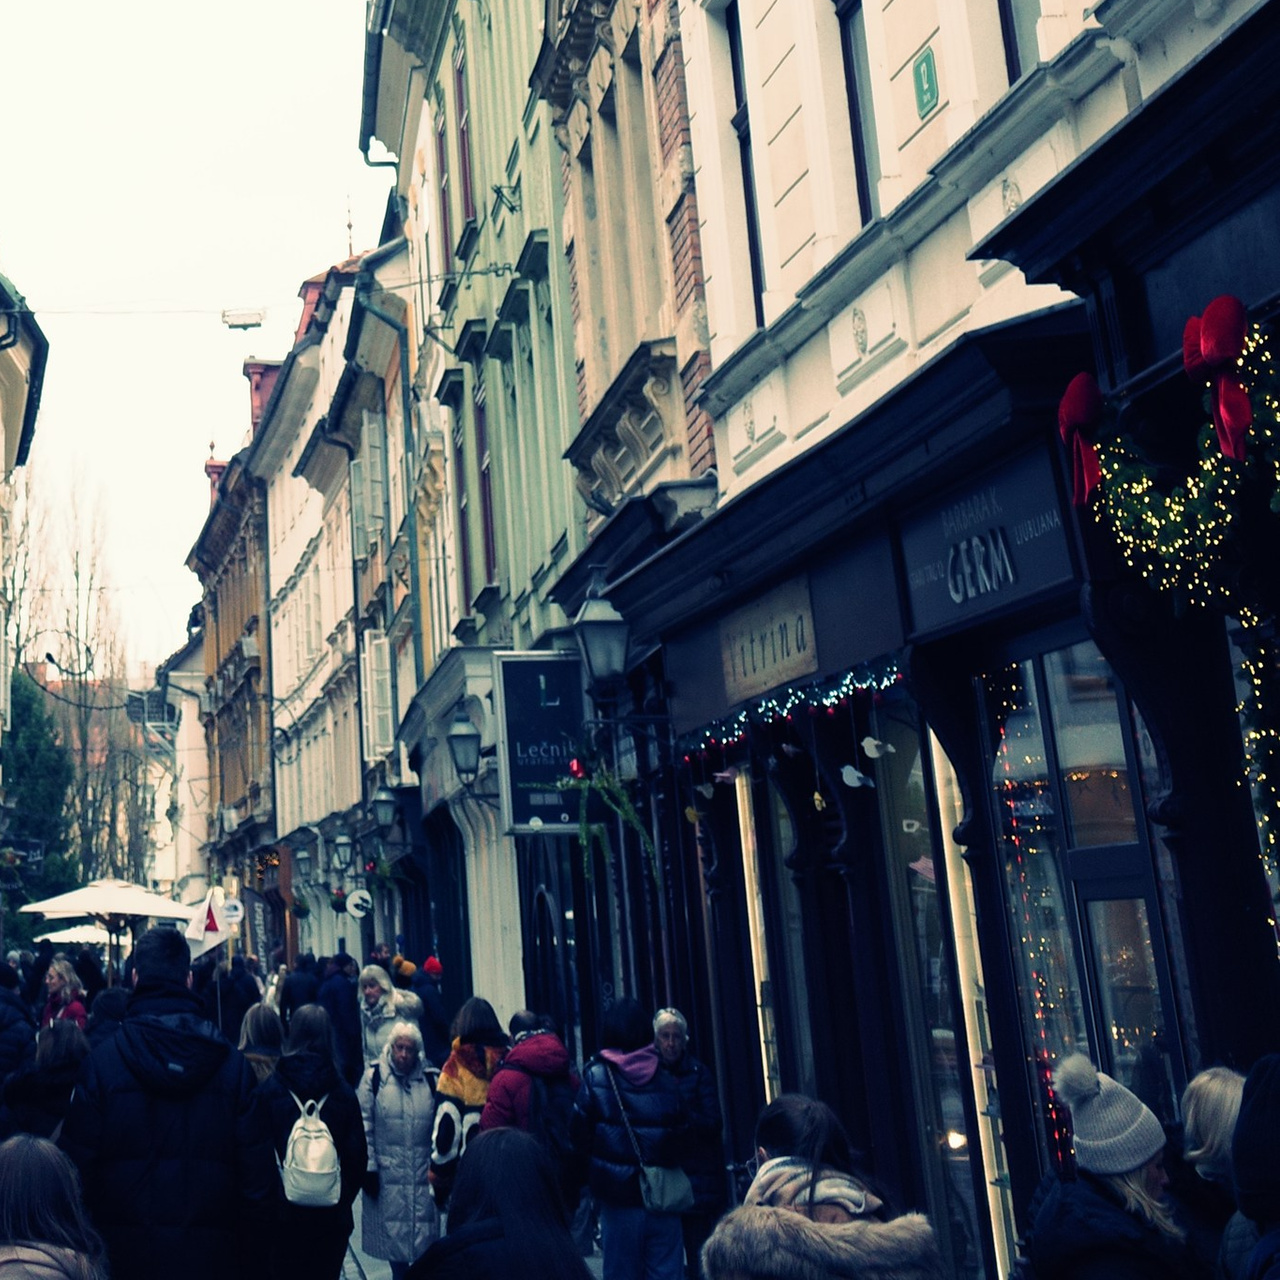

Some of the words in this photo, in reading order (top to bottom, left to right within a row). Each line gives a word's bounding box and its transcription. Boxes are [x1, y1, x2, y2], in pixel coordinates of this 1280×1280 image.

[941, 492, 990, 538] BARBARA
[1014, 509, 1061, 545] LJUBLJANA
[947, 528, 1015, 604] GERM
[725, 613, 807, 682] Vitrina
